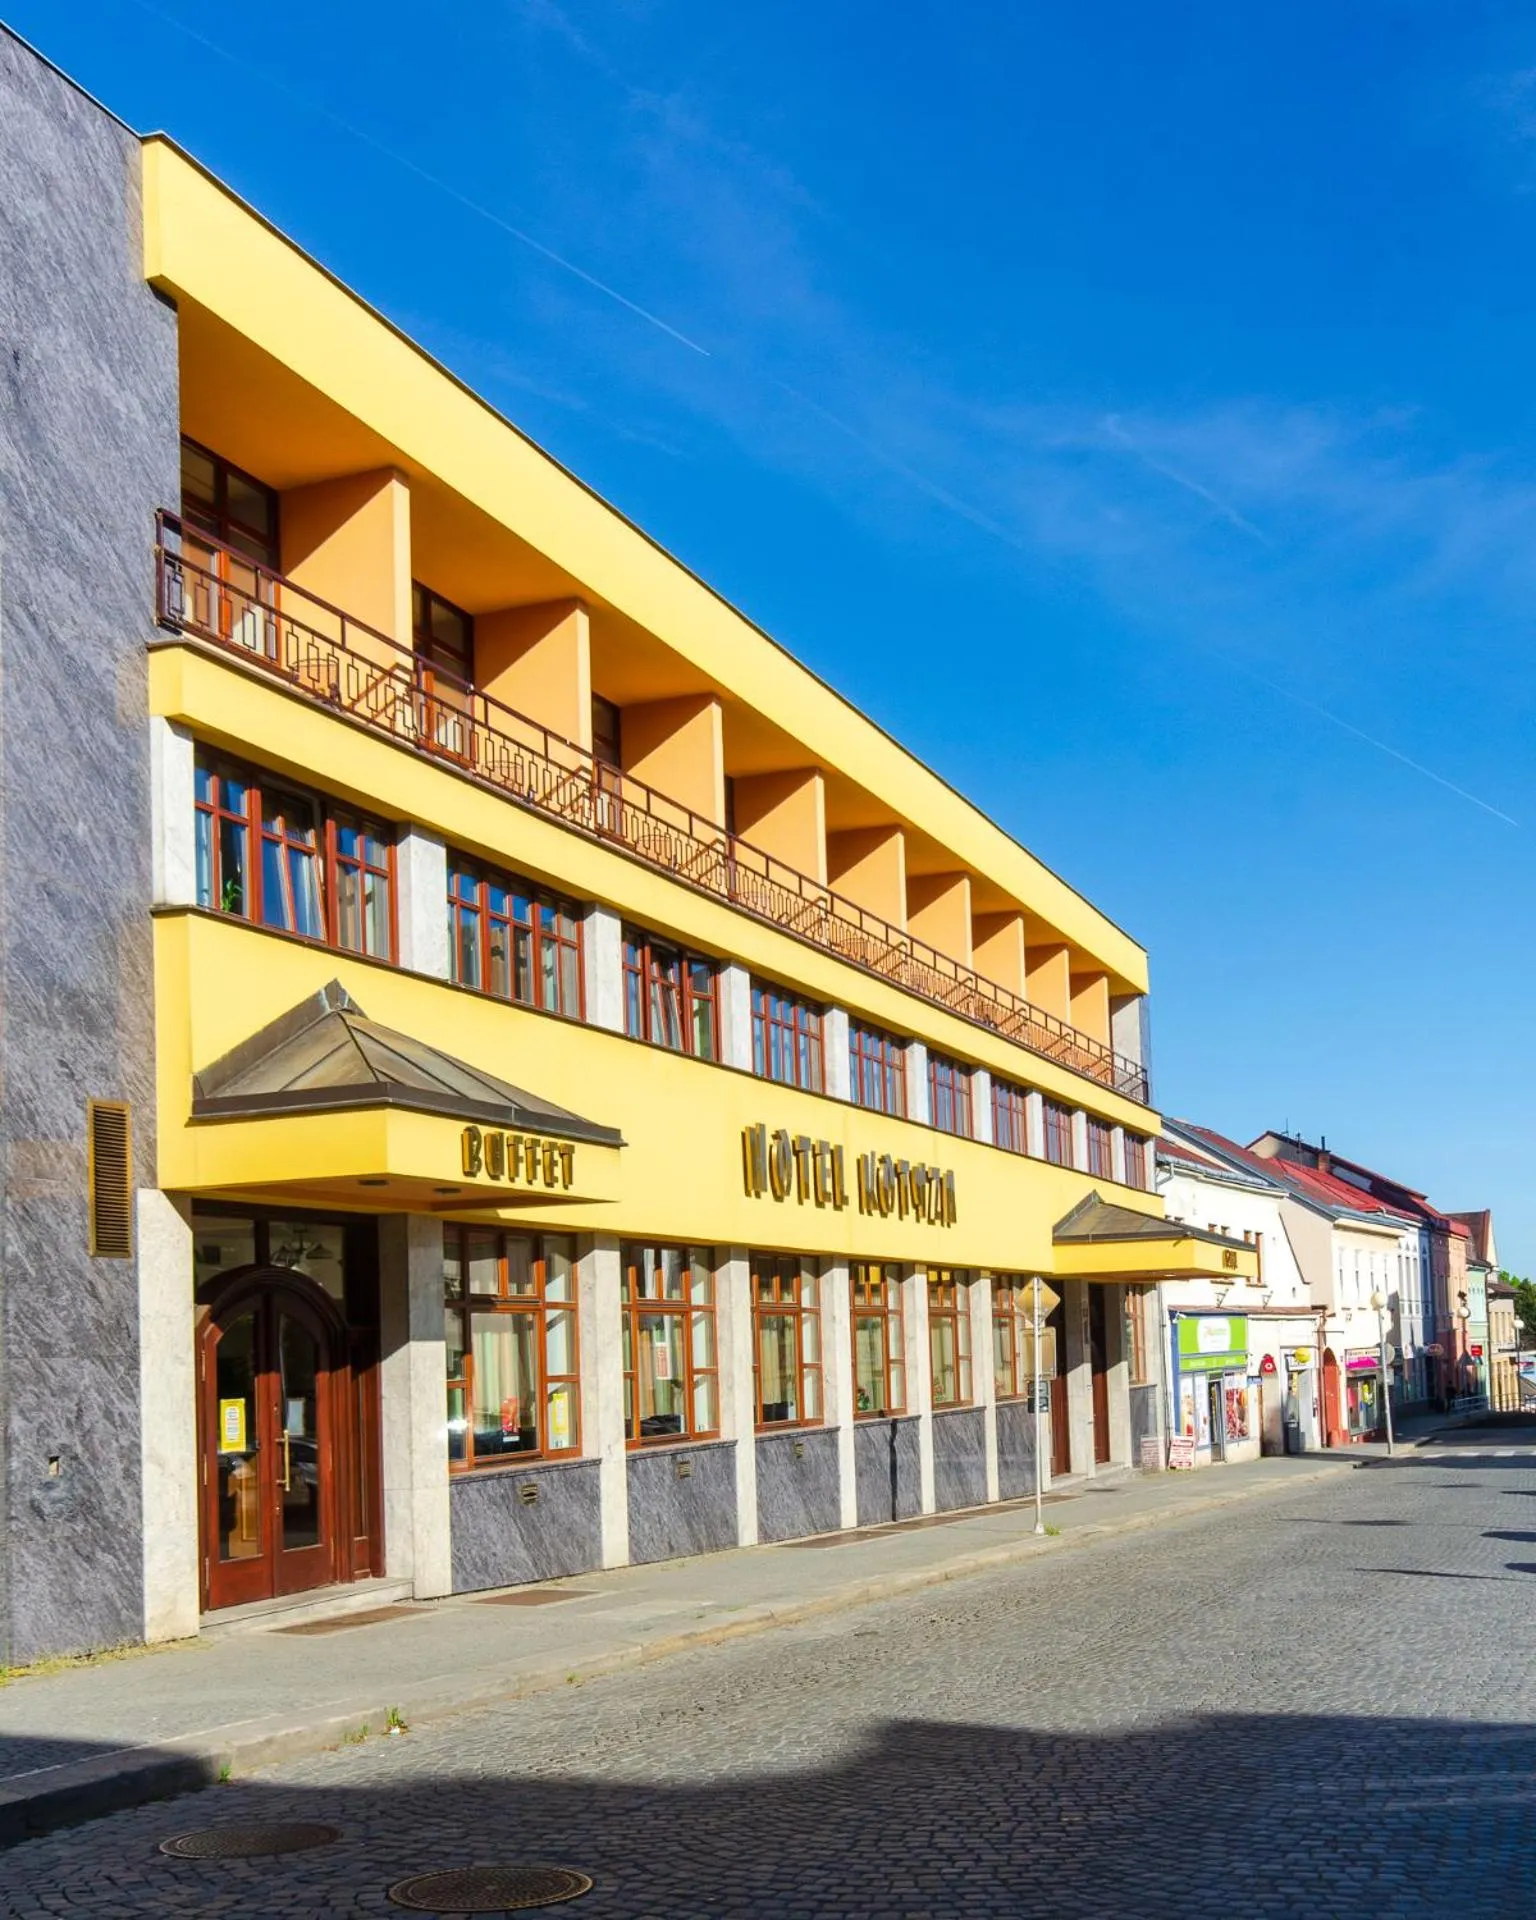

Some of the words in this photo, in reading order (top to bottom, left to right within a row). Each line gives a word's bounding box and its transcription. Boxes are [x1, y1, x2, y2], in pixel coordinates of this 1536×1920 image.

[461, 1125, 576, 1190] BUFFET
[741, 1122, 849, 1211] HOTEL
[856, 1150, 957, 1228] KOTYZA
